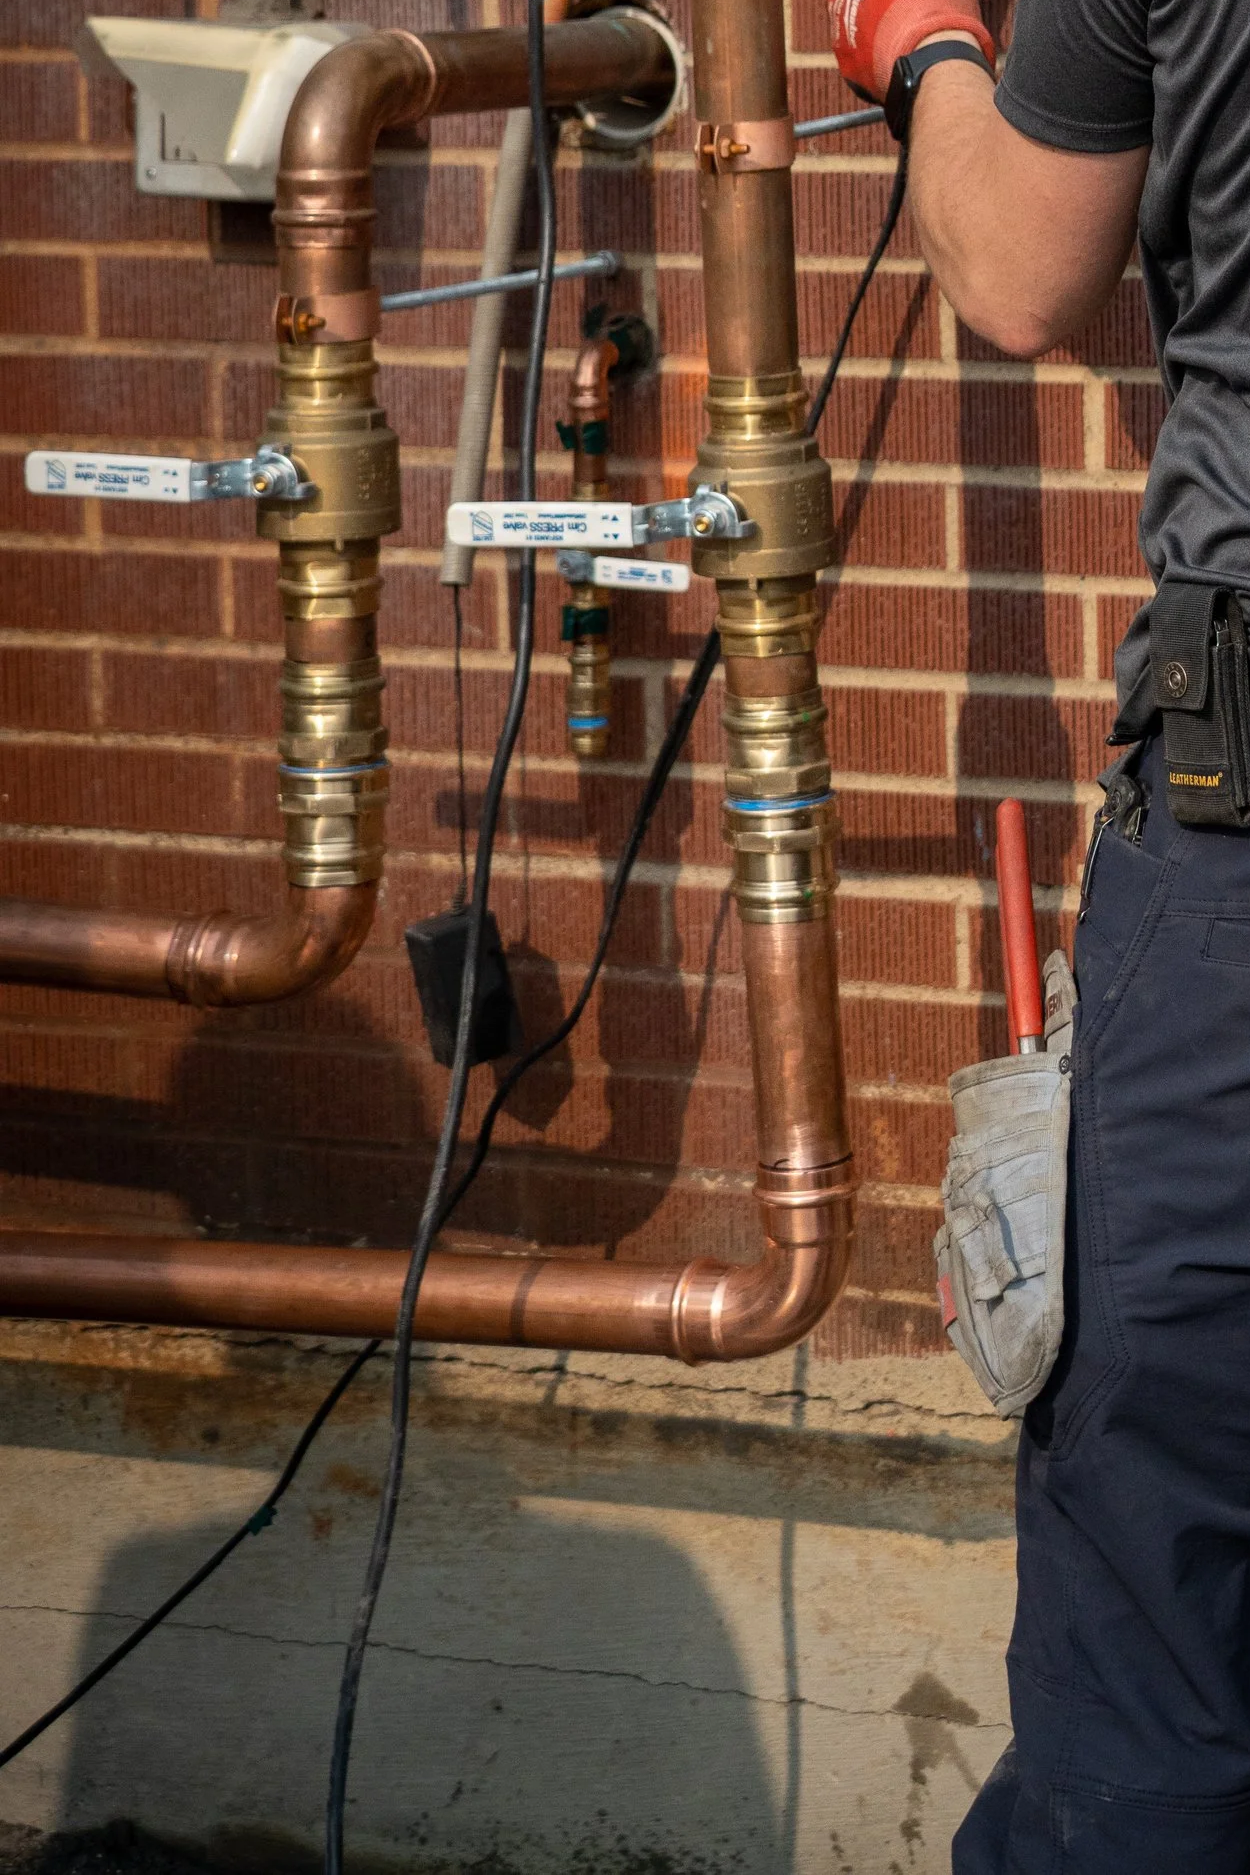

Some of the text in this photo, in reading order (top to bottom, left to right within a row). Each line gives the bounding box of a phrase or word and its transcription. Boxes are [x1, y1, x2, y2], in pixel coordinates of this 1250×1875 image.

[98, 473, 129, 485] PRESS
[502, 522, 528, 533] valve
[529, 522, 565, 533] PRESS
[567, 522, 588, 534] Cim
